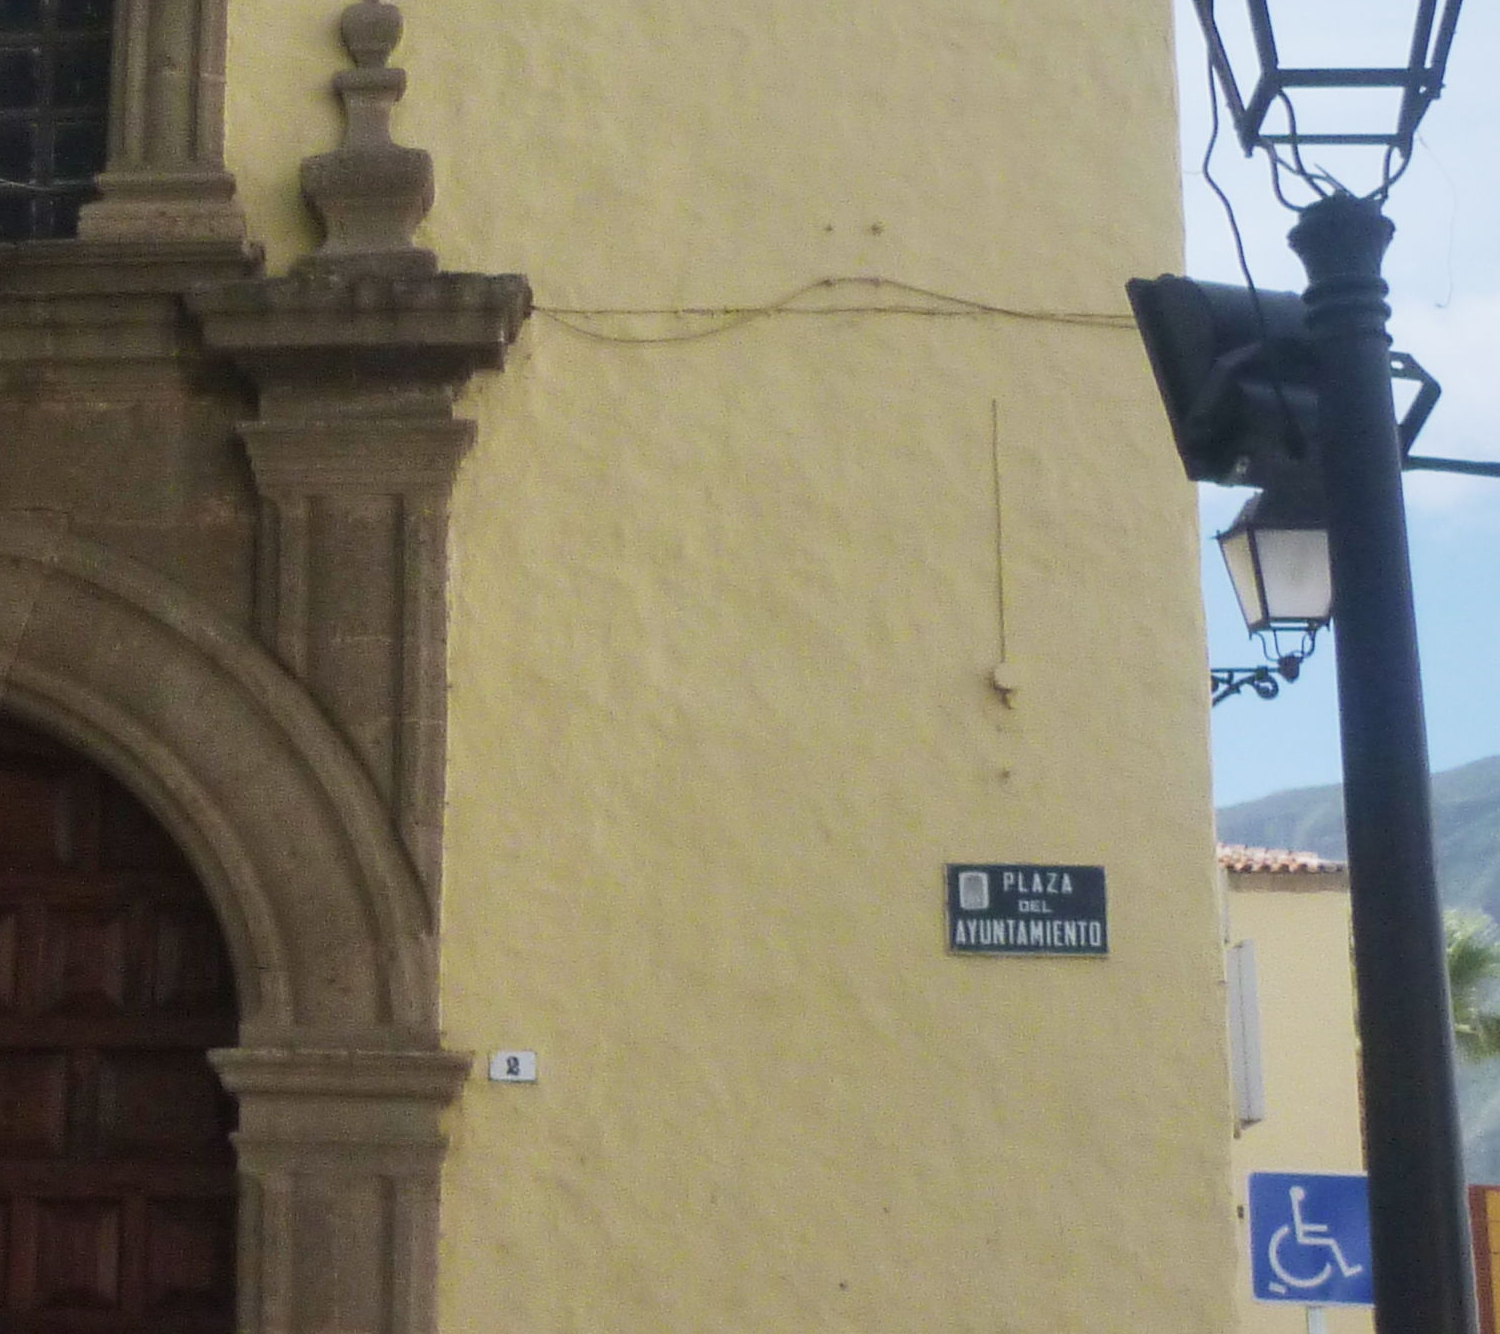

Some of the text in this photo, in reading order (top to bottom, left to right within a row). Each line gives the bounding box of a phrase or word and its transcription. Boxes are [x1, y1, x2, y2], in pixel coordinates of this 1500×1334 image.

[1003, 870, 1073, 894] PLAZA
[1018, 899, 1053, 913] DEL
[955, 918, 1101, 946] AYUNTAMIENTO
